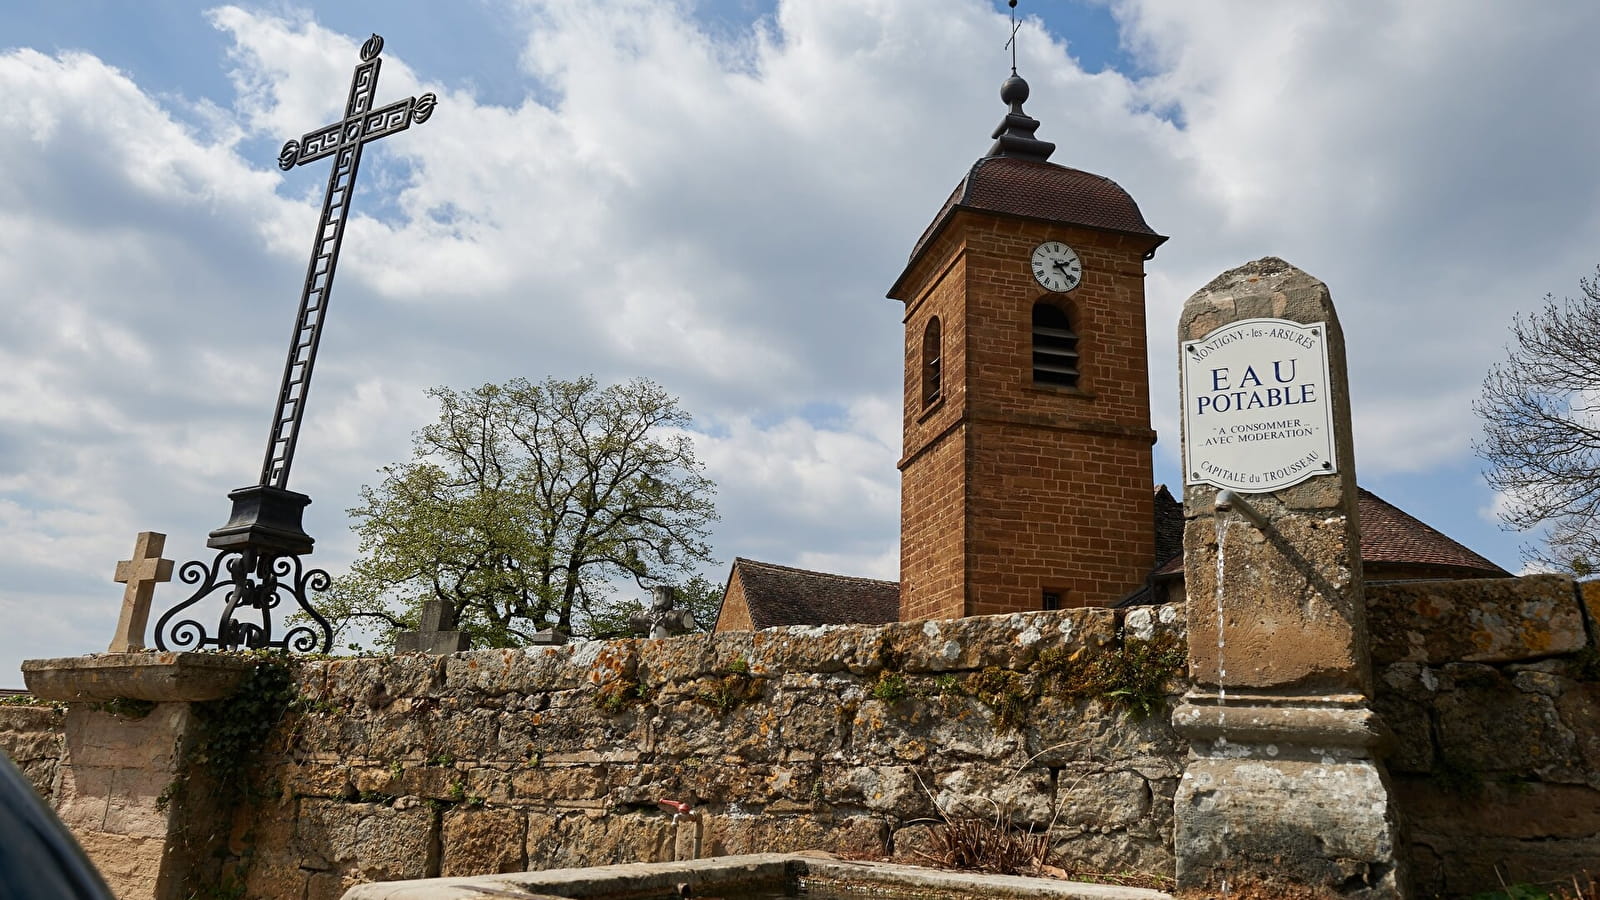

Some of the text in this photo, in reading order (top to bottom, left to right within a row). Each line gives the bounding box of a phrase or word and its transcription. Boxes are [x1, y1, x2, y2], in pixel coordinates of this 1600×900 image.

[1210, 358, 1297, 392] EAU
[1197, 383, 1317, 415] POTABLE
[1200, 450, 1319, 483] CAPITALE du TROUSSEAU
